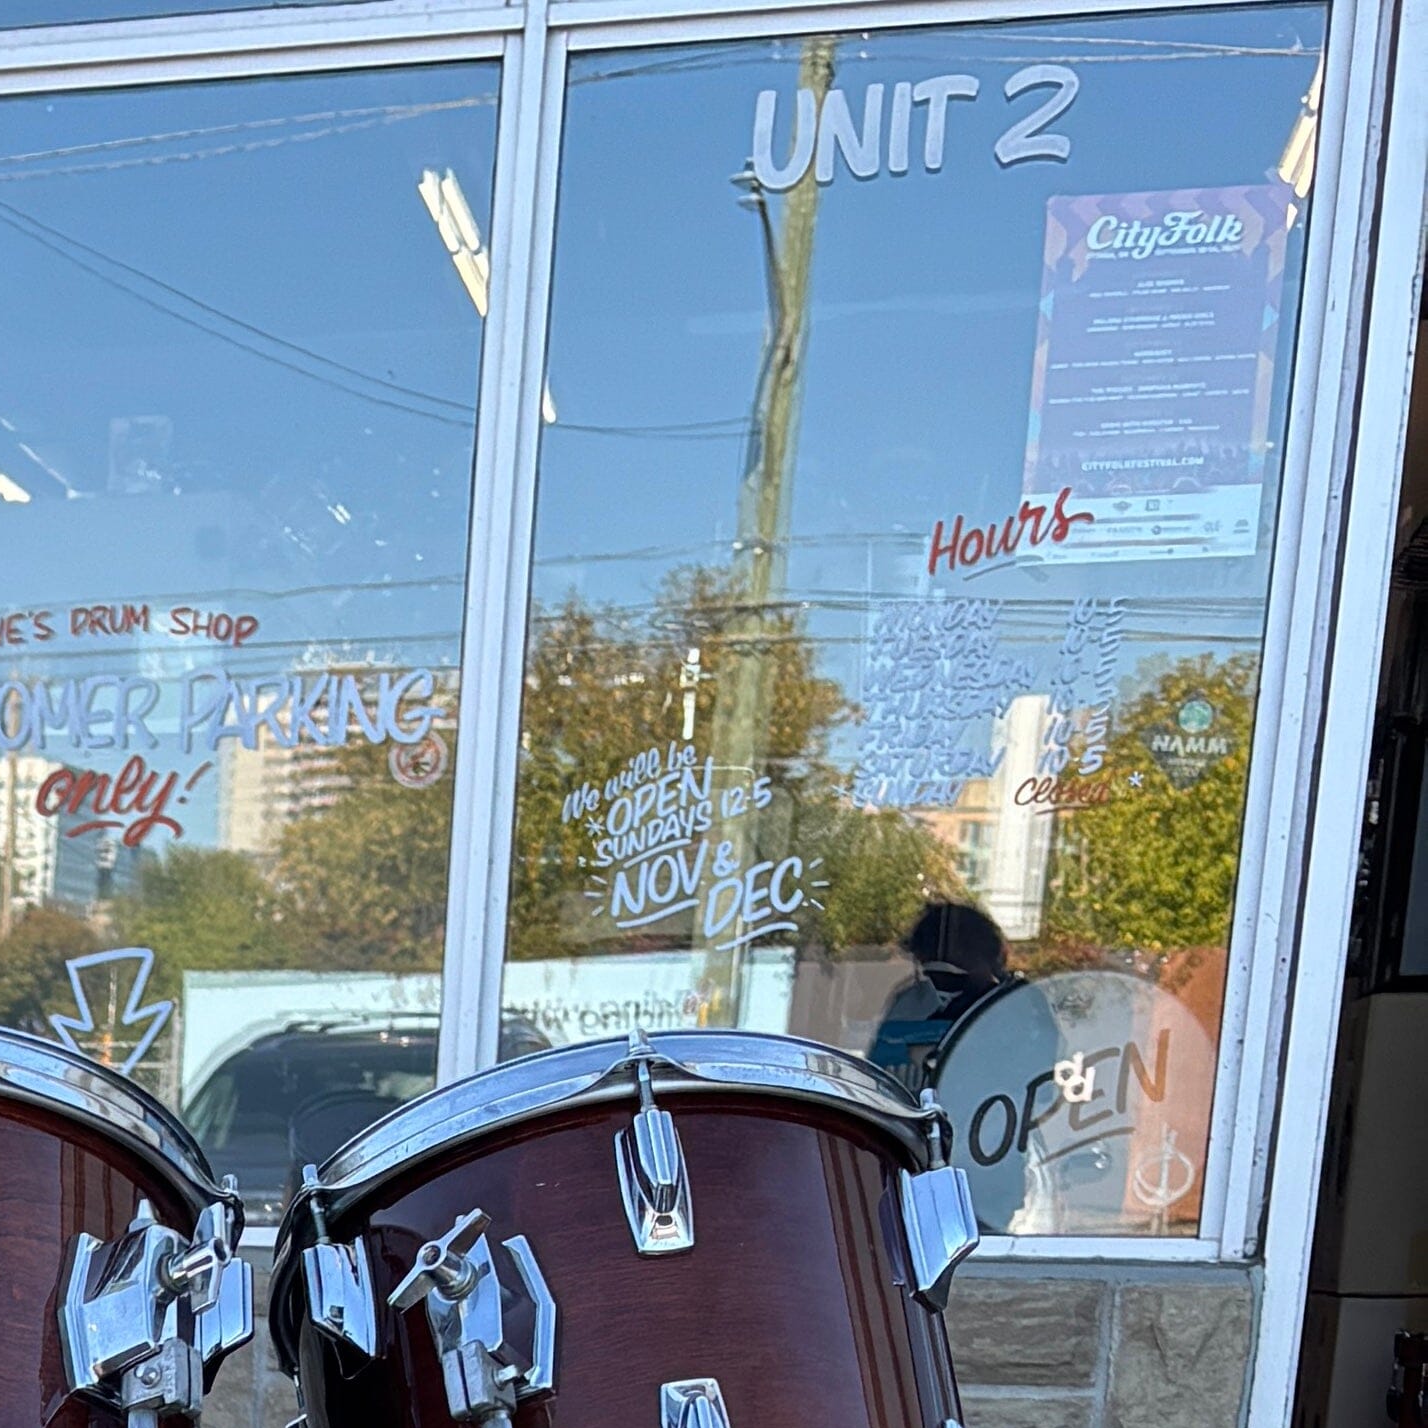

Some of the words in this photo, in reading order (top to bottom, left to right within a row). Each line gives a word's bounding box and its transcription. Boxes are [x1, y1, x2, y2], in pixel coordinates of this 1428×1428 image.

[753, 74, 980, 192] UNIT
[994, 64, 1080, 167] 2
[1086, 211, 1243, 259] CityFolk
[71, 604, 150, 636] DRUM
[170, 607, 259, 647] SHOP
[180, 667, 443, 753] PARKING
[1151, 735, 1227, 757] NAMM
[36, 755, 213, 847] only!
[604, 747, 660, 801] will
[668, 740, 698, 770] be
[606, 756, 713, 836] OPEN
[595, 800, 713, 867] SUNDAYS
[712, 840, 740, 877] &
[611, 839, 708, 917] NOV
[704, 856, 804, 938] DEC
[969, 1029, 1171, 1167] OPEN
